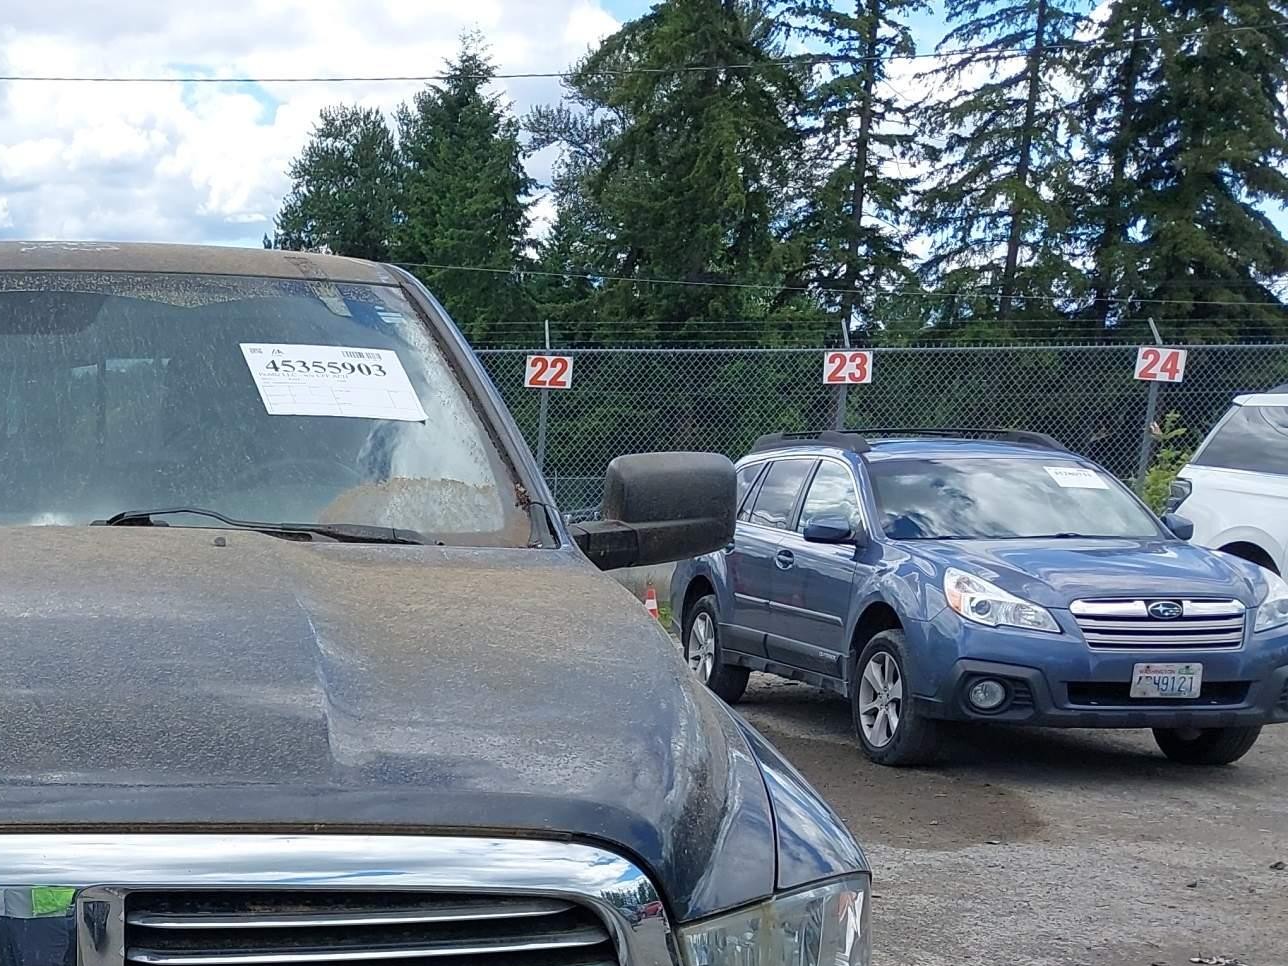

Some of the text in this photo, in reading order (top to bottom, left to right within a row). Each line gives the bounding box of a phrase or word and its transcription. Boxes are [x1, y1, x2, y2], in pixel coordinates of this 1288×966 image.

[265, 359, 387, 377] 45355903
[529, 357, 568, 386] 22
[827, 353, 868, 382] 23
[1138, 349, 1180, 380] 24
